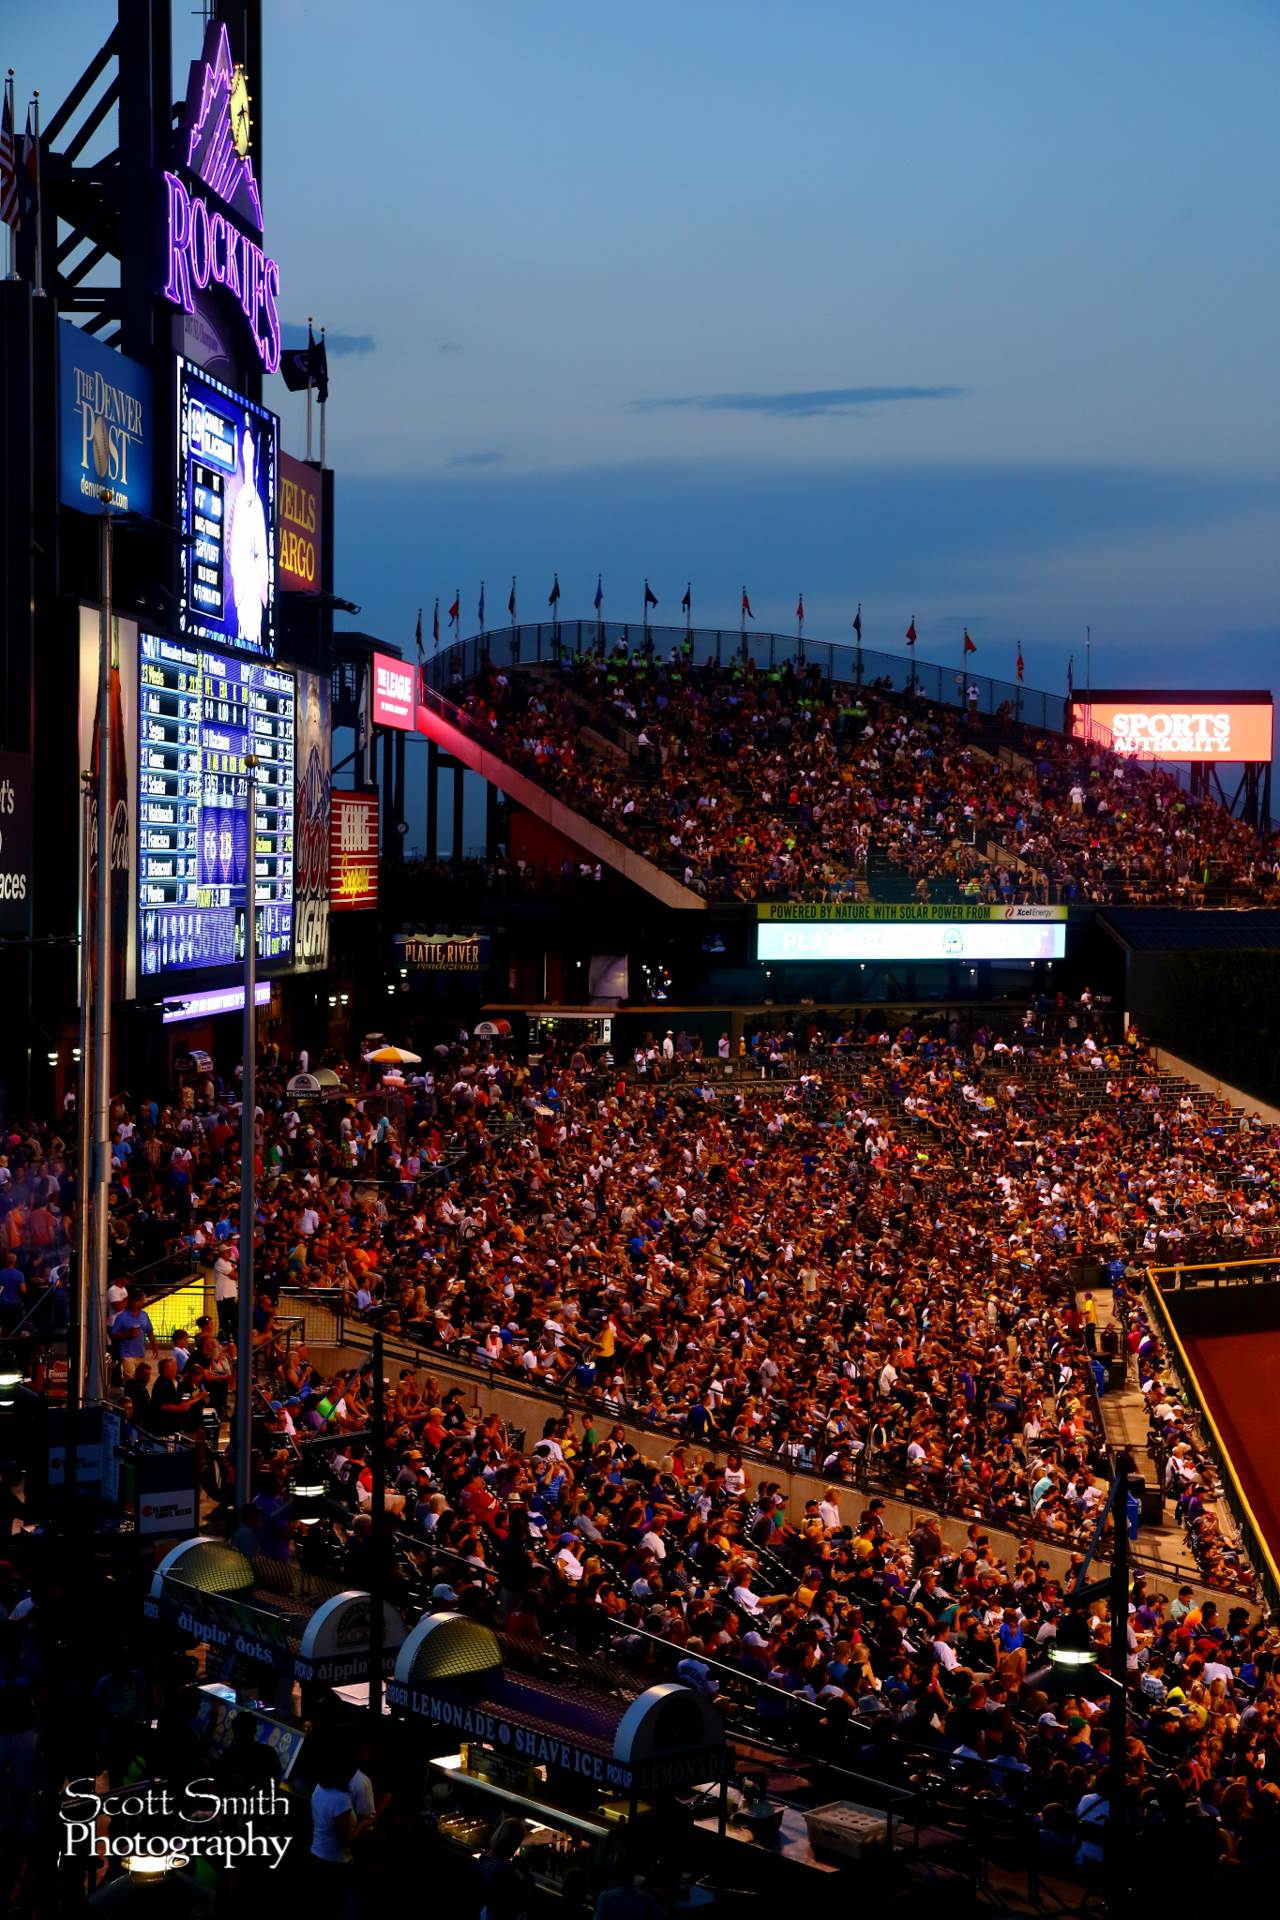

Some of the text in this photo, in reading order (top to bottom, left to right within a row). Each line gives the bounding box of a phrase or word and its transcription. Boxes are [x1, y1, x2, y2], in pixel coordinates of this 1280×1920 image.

[163, 170, 281, 374] ROCKIES
[74, 367, 143, 436] THE DENVER
[1112, 713, 1231, 738] SPORTS
[341, 805, 370, 851] KING
[295, 900, 330, 972] LIGHT
[770, 905, 817, 919] POWERED
[820, 905, 832, 919] BY
[835, 905, 870, 919] NATURE
[873, 905, 897, 919] WITH
[900, 905, 928, 919] SOLAR
[931, 905, 963, 919] POWER
[966, 905, 991, 918] FROM
[405, 944, 479, 963] PLATTE RIVER
[177, 1611, 273, 1665] dippin' dots
[412, 1690, 496, 1741] LEMONADE
[514, 1728, 571, 1768] SHAVE
[573, 1750, 604, 1781] ICE
[641, 1751, 730, 1790] LEMONADE
